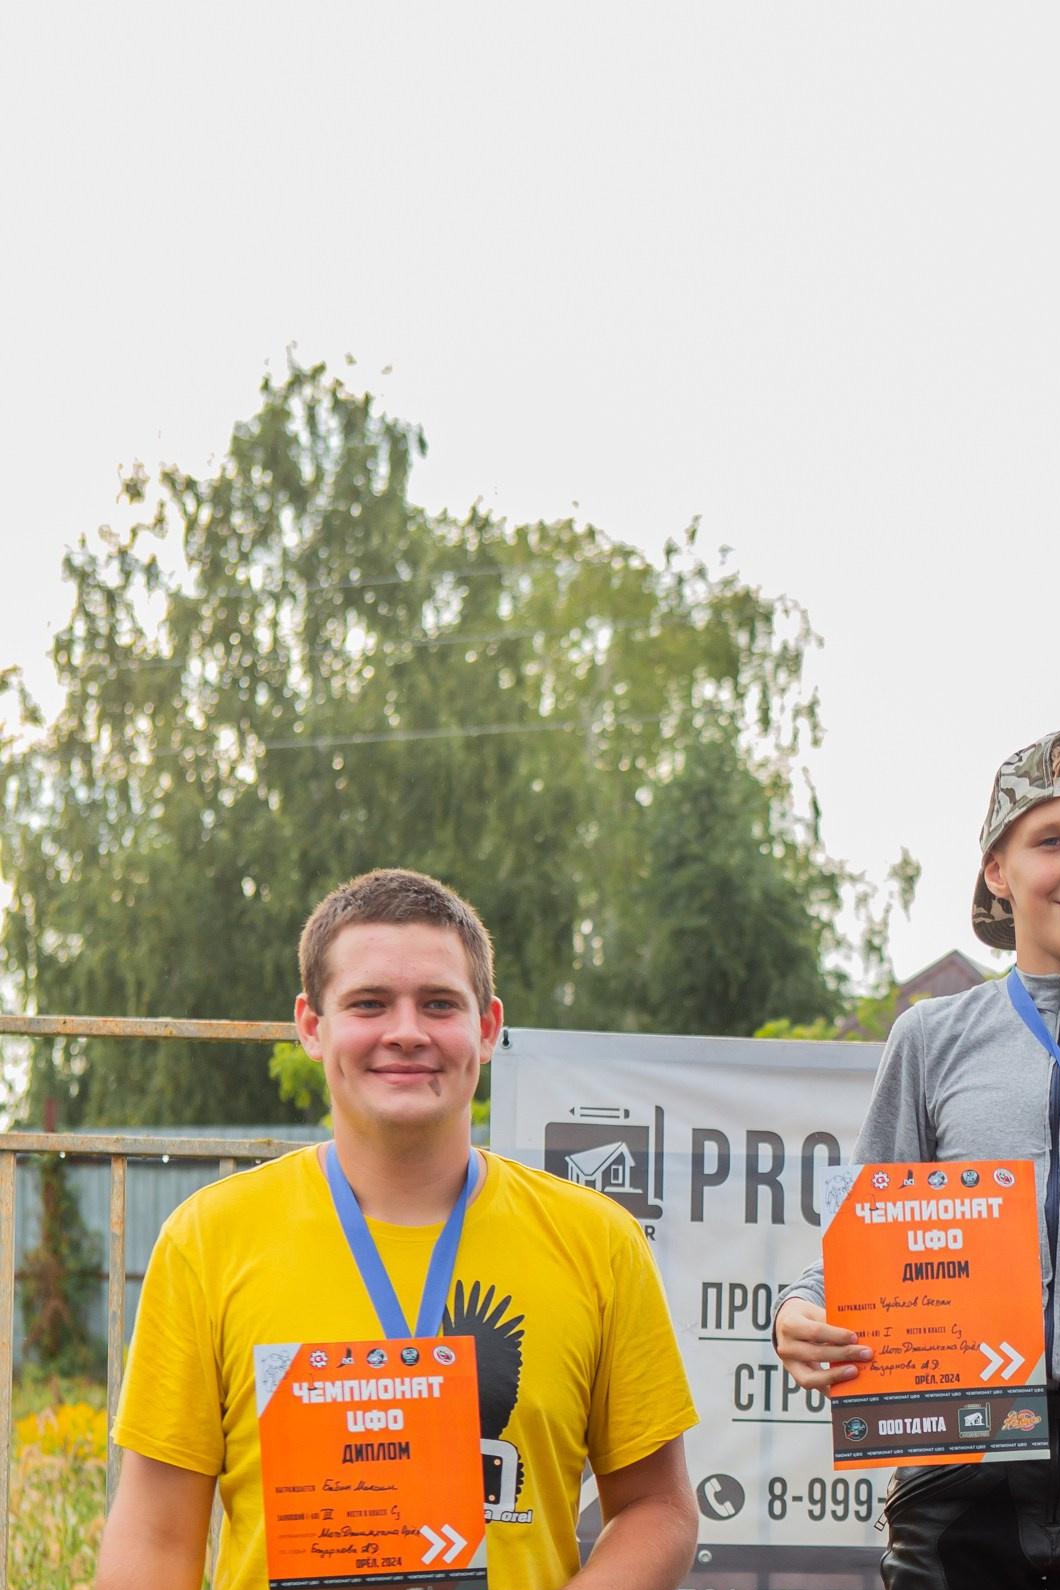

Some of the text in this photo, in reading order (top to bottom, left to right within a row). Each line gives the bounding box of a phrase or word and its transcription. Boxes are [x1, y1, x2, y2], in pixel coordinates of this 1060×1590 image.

[690, 1127, 841, 1227] PRO
[855, 1197, 1003, 1224] ЧЕМПИОНАТ
[908, 1229, 963, 1251] ЦФО
[903, 1260, 969, 1282] ДИПЛОМ
[701, 1282, 790, 1331] ПРО
[734, 1363, 825, 1412] СТРО
[940, 1373, 960, 1383] 2024
[293, 1376, 443, 1404] ЧЕМПИОНАТ
[346, 1409, 404, 1432] ЦФО
[878, 1416, 946, 1435] ООО ТД ИТА
[342, 1442, 410, 1464] ДИПЛОМ
[768, 1476, 887, 1522] 8-999-
[501, 1510, 533, 1523] orel
[382, 1557, 402, 1566] 2024
